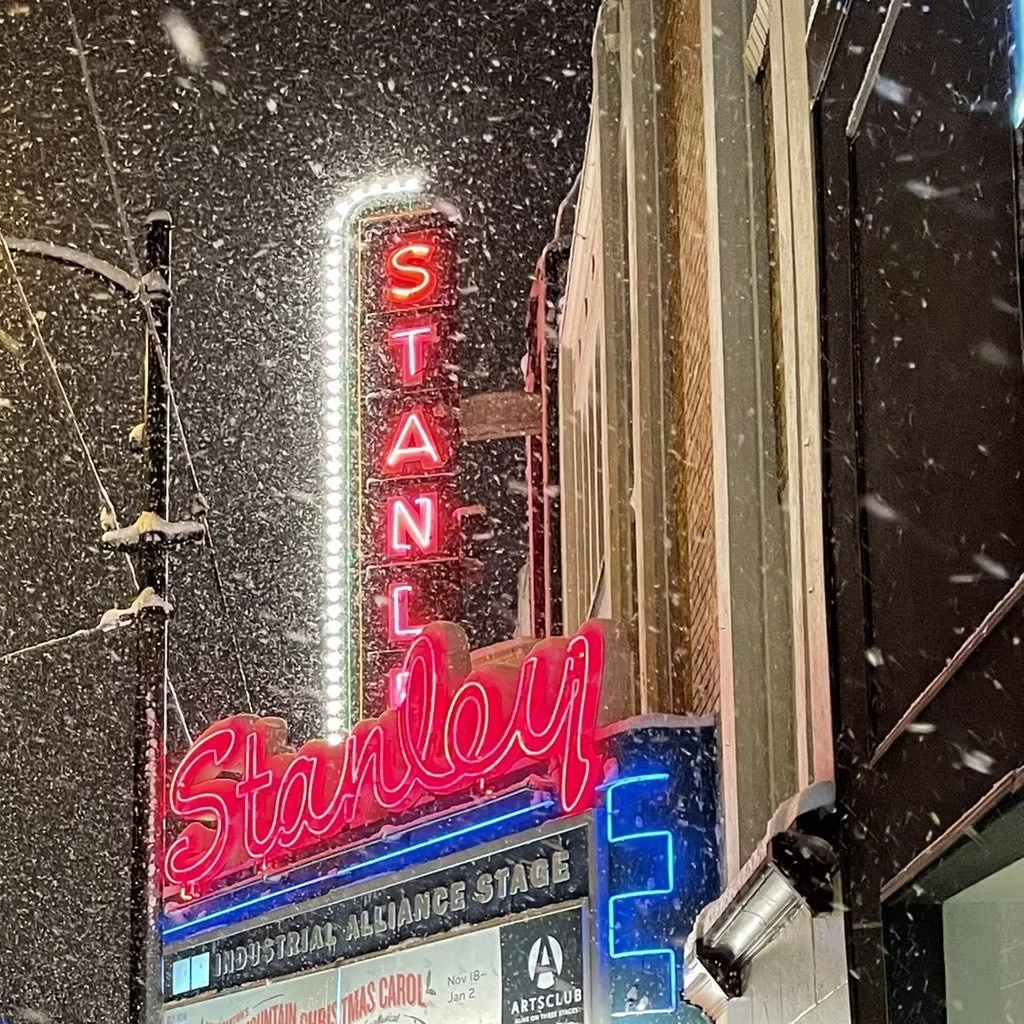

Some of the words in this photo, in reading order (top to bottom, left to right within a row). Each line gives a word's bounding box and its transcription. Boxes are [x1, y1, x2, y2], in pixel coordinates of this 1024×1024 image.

[163, 622, 604, 886] Stanley
[214, 921, 337, 977] INDUSTRIAL
[346, 880, 466, 942] ALLIANCE
[473, 850, 571, 904] STAGE
[378, 972, 428, 1009] CAROL
[447, 974, 467, 987] Nov
[447, 990, 466, 1003] Jan
[468, 988, 476, 999] 2
[511, 988, 582, 1015] ARTSCLUB
